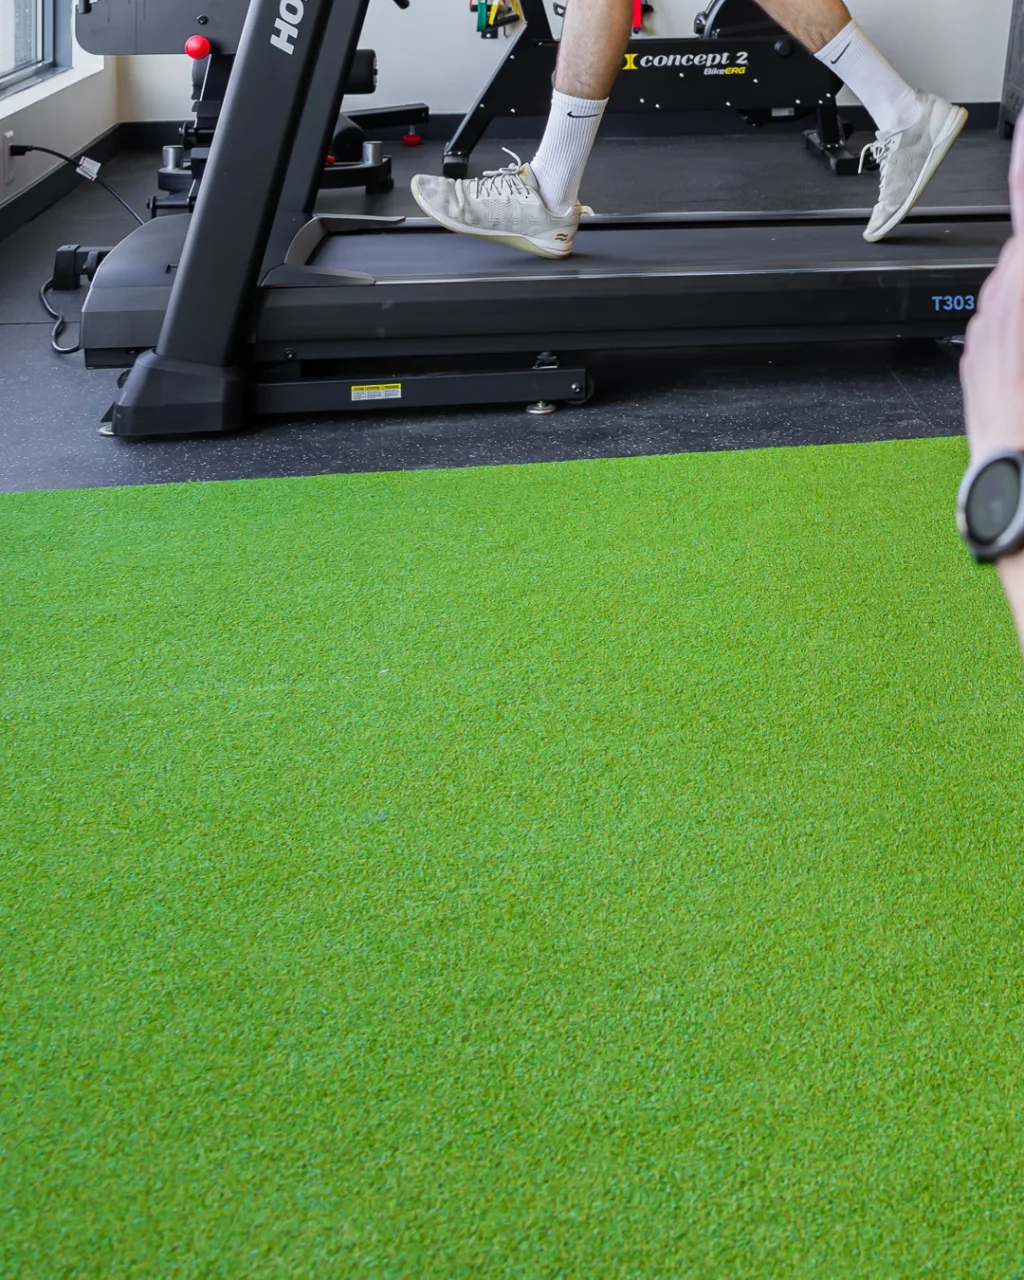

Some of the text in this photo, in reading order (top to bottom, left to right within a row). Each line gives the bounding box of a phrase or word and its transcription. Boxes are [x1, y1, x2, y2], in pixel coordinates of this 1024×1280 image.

[640, 51, 749, 67] concept 2
[703, 66, 746, 75] BikeERG
[931, 294, 975, 311] T303
